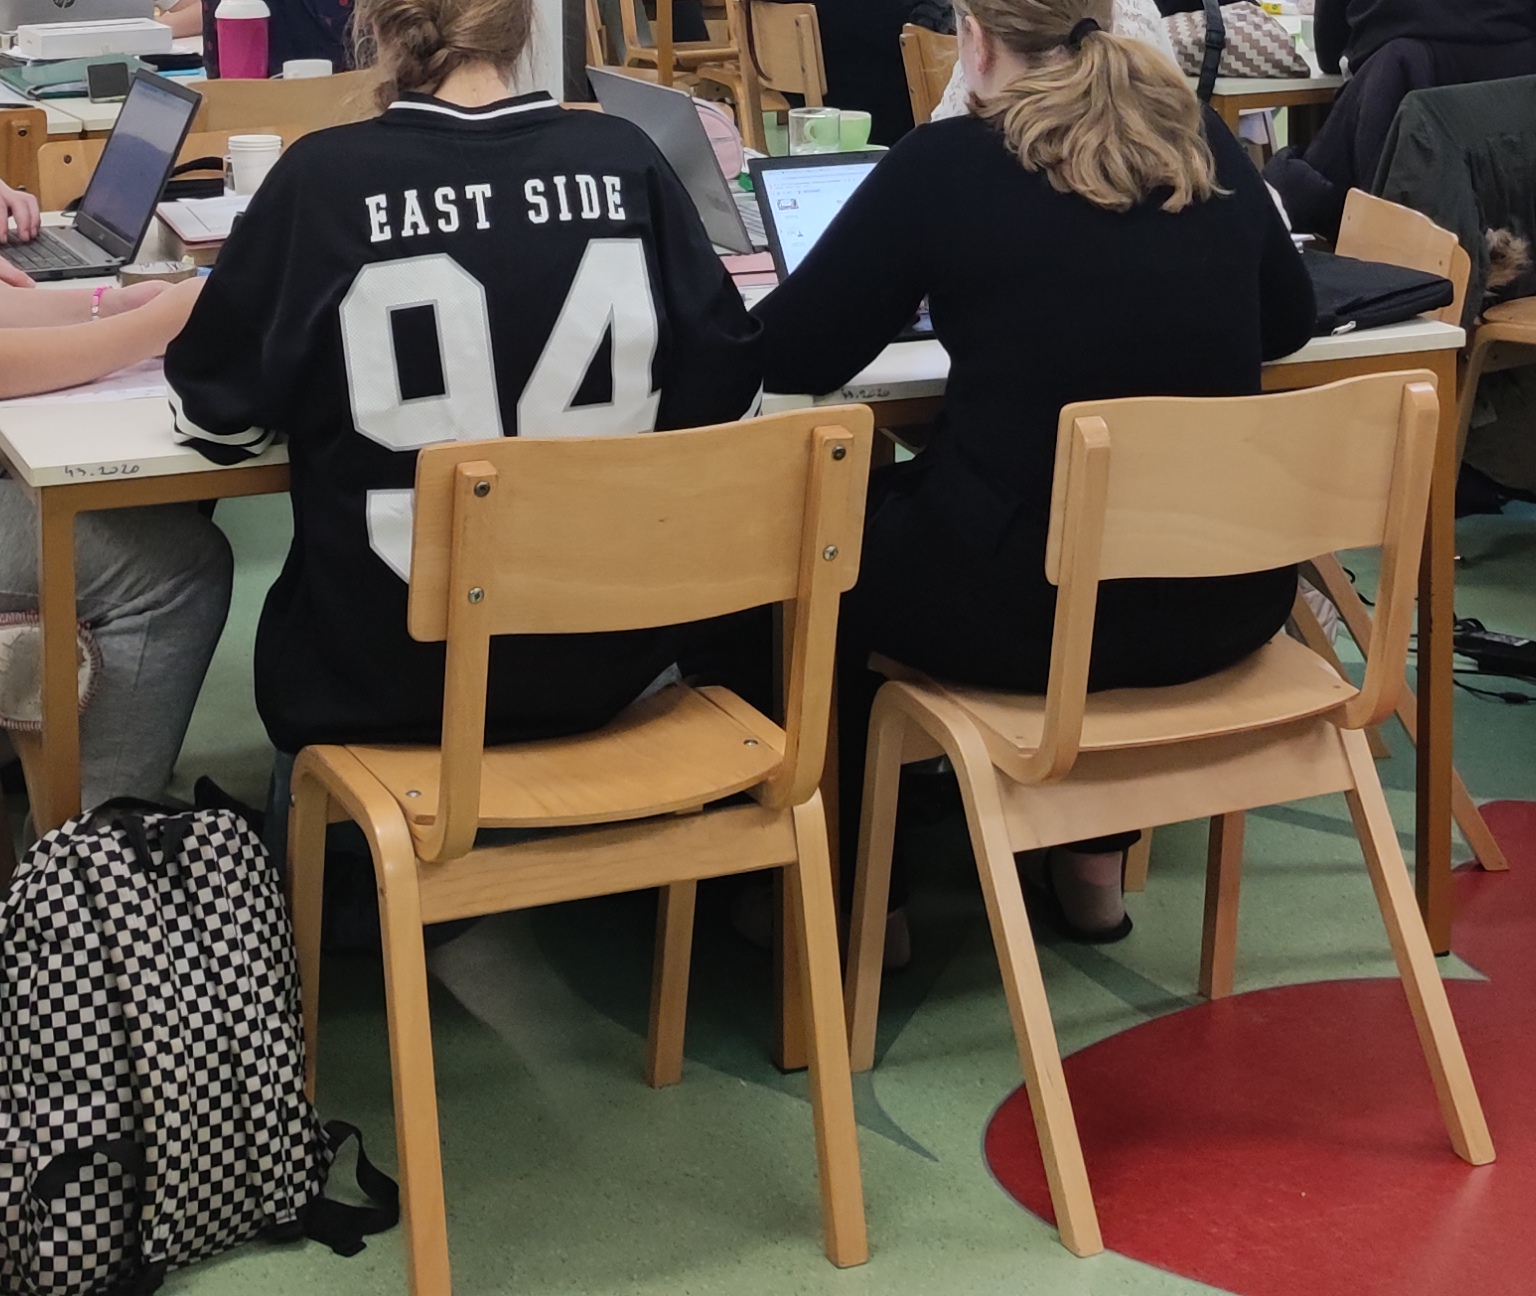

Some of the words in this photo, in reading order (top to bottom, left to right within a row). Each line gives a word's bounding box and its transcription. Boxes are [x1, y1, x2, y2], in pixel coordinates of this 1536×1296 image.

[365, 183, 492, 243] EAST
[523, 174, 626, 224] SIDE
[339, 237, 662, 584] 94
